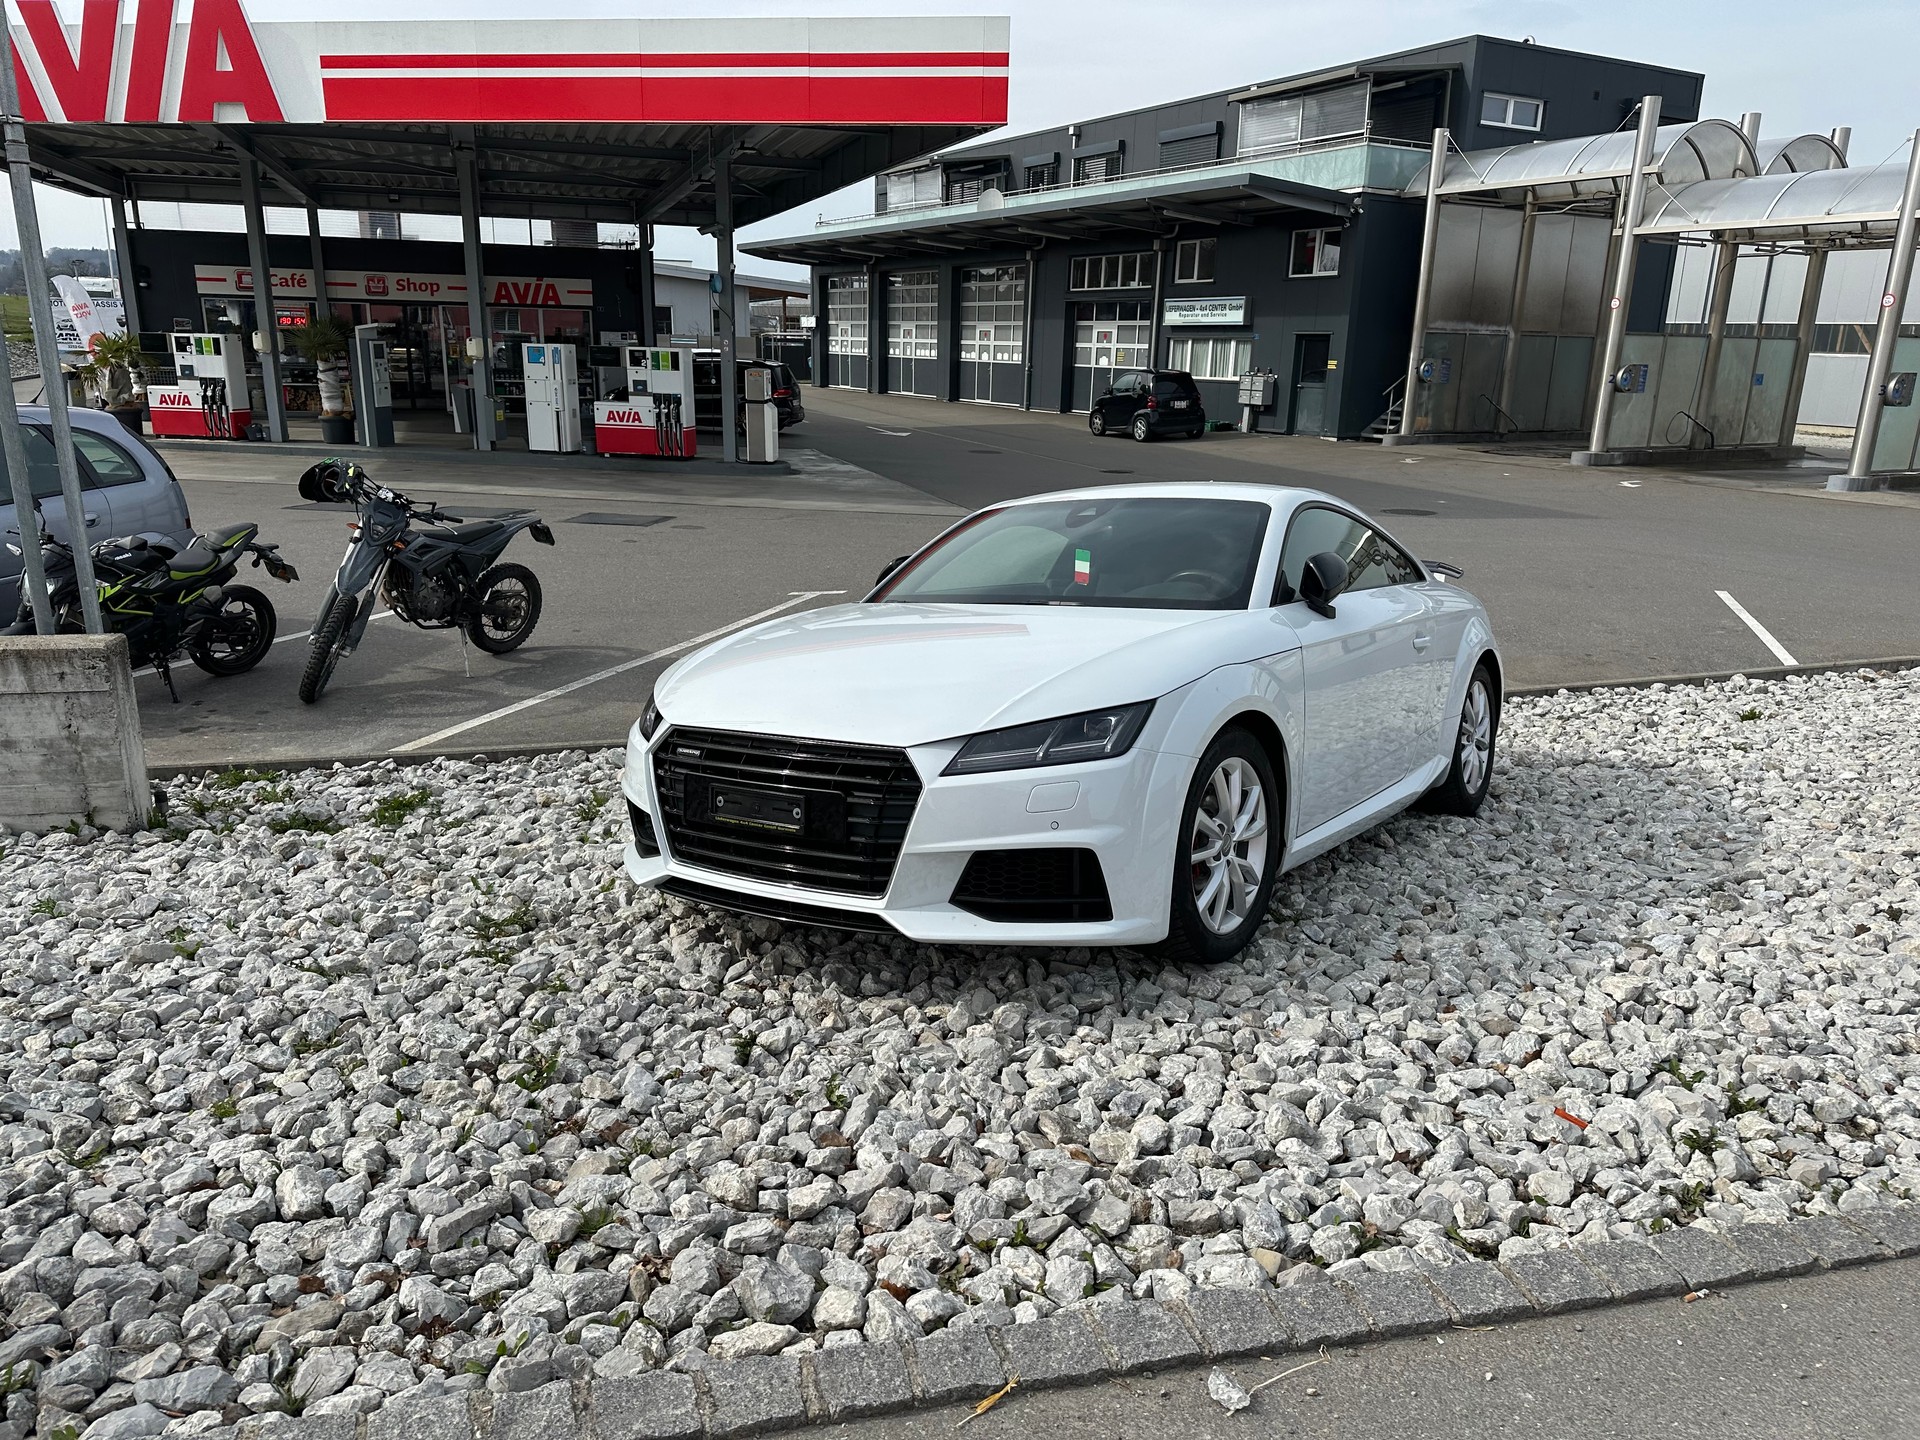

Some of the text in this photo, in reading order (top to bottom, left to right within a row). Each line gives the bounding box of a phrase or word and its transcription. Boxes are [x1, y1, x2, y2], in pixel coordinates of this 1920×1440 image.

[10, 0, 285, 123] VIA
[269, 273, 308, 288] Café
[396, 277, 441, 296] Shop
[1165, 304, 1196, 312] LIEFERWAGEN
[1208, 303, 1228, 311] CENTER
[1228, 302, 1243, 311] GmbH
[641, 359, 647, 367] 2
[1608, 375, 1616, 384] 2
[1878, 385, 1887, 396] 3
